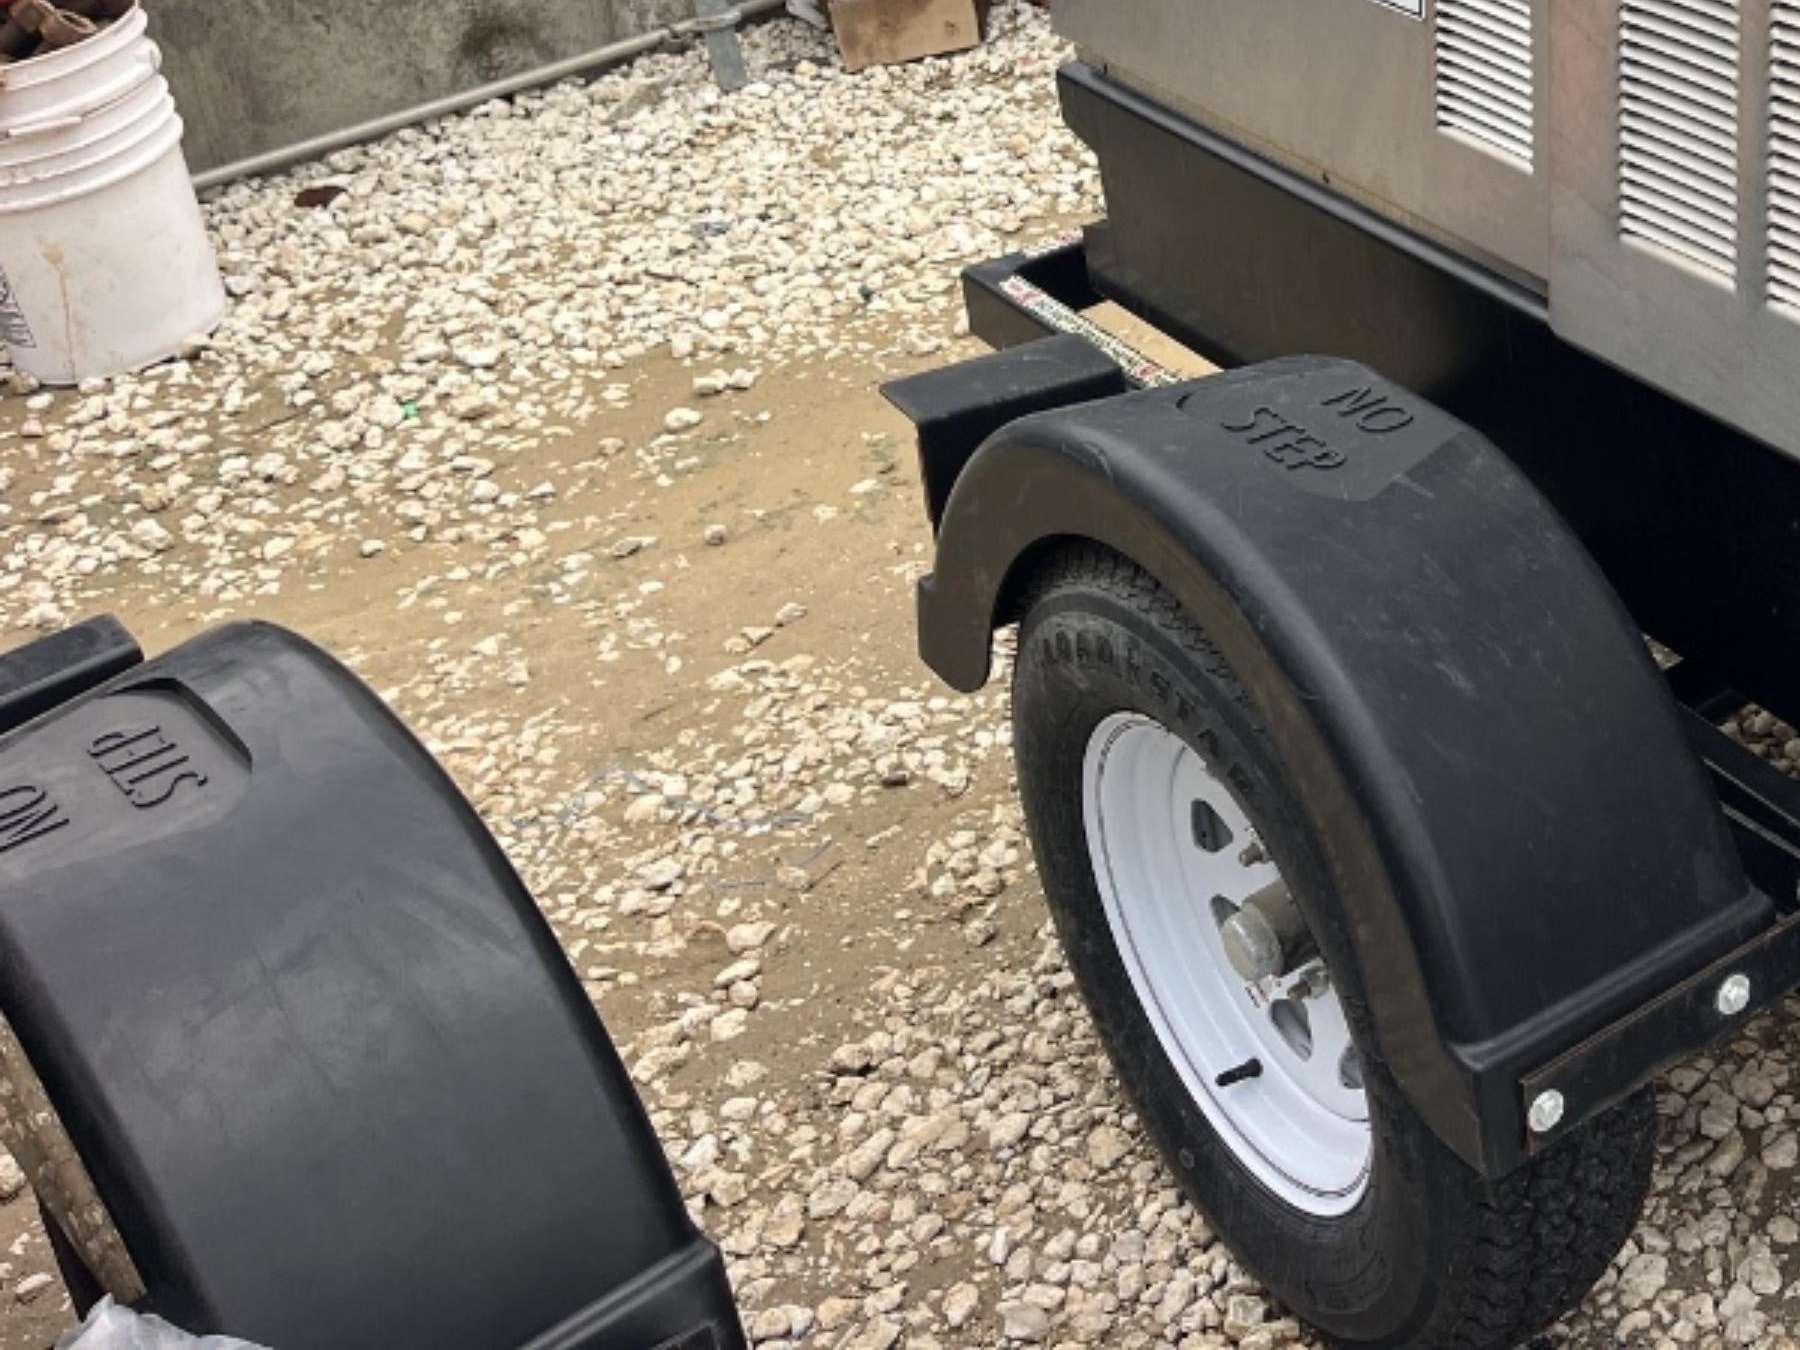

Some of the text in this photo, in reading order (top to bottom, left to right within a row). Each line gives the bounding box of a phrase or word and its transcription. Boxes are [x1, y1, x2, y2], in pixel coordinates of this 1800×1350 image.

[1220, 406, 1348, 471] STEP
[1321, 386, 1414, 433] NO
[87, 724, 208, 808] STEP
